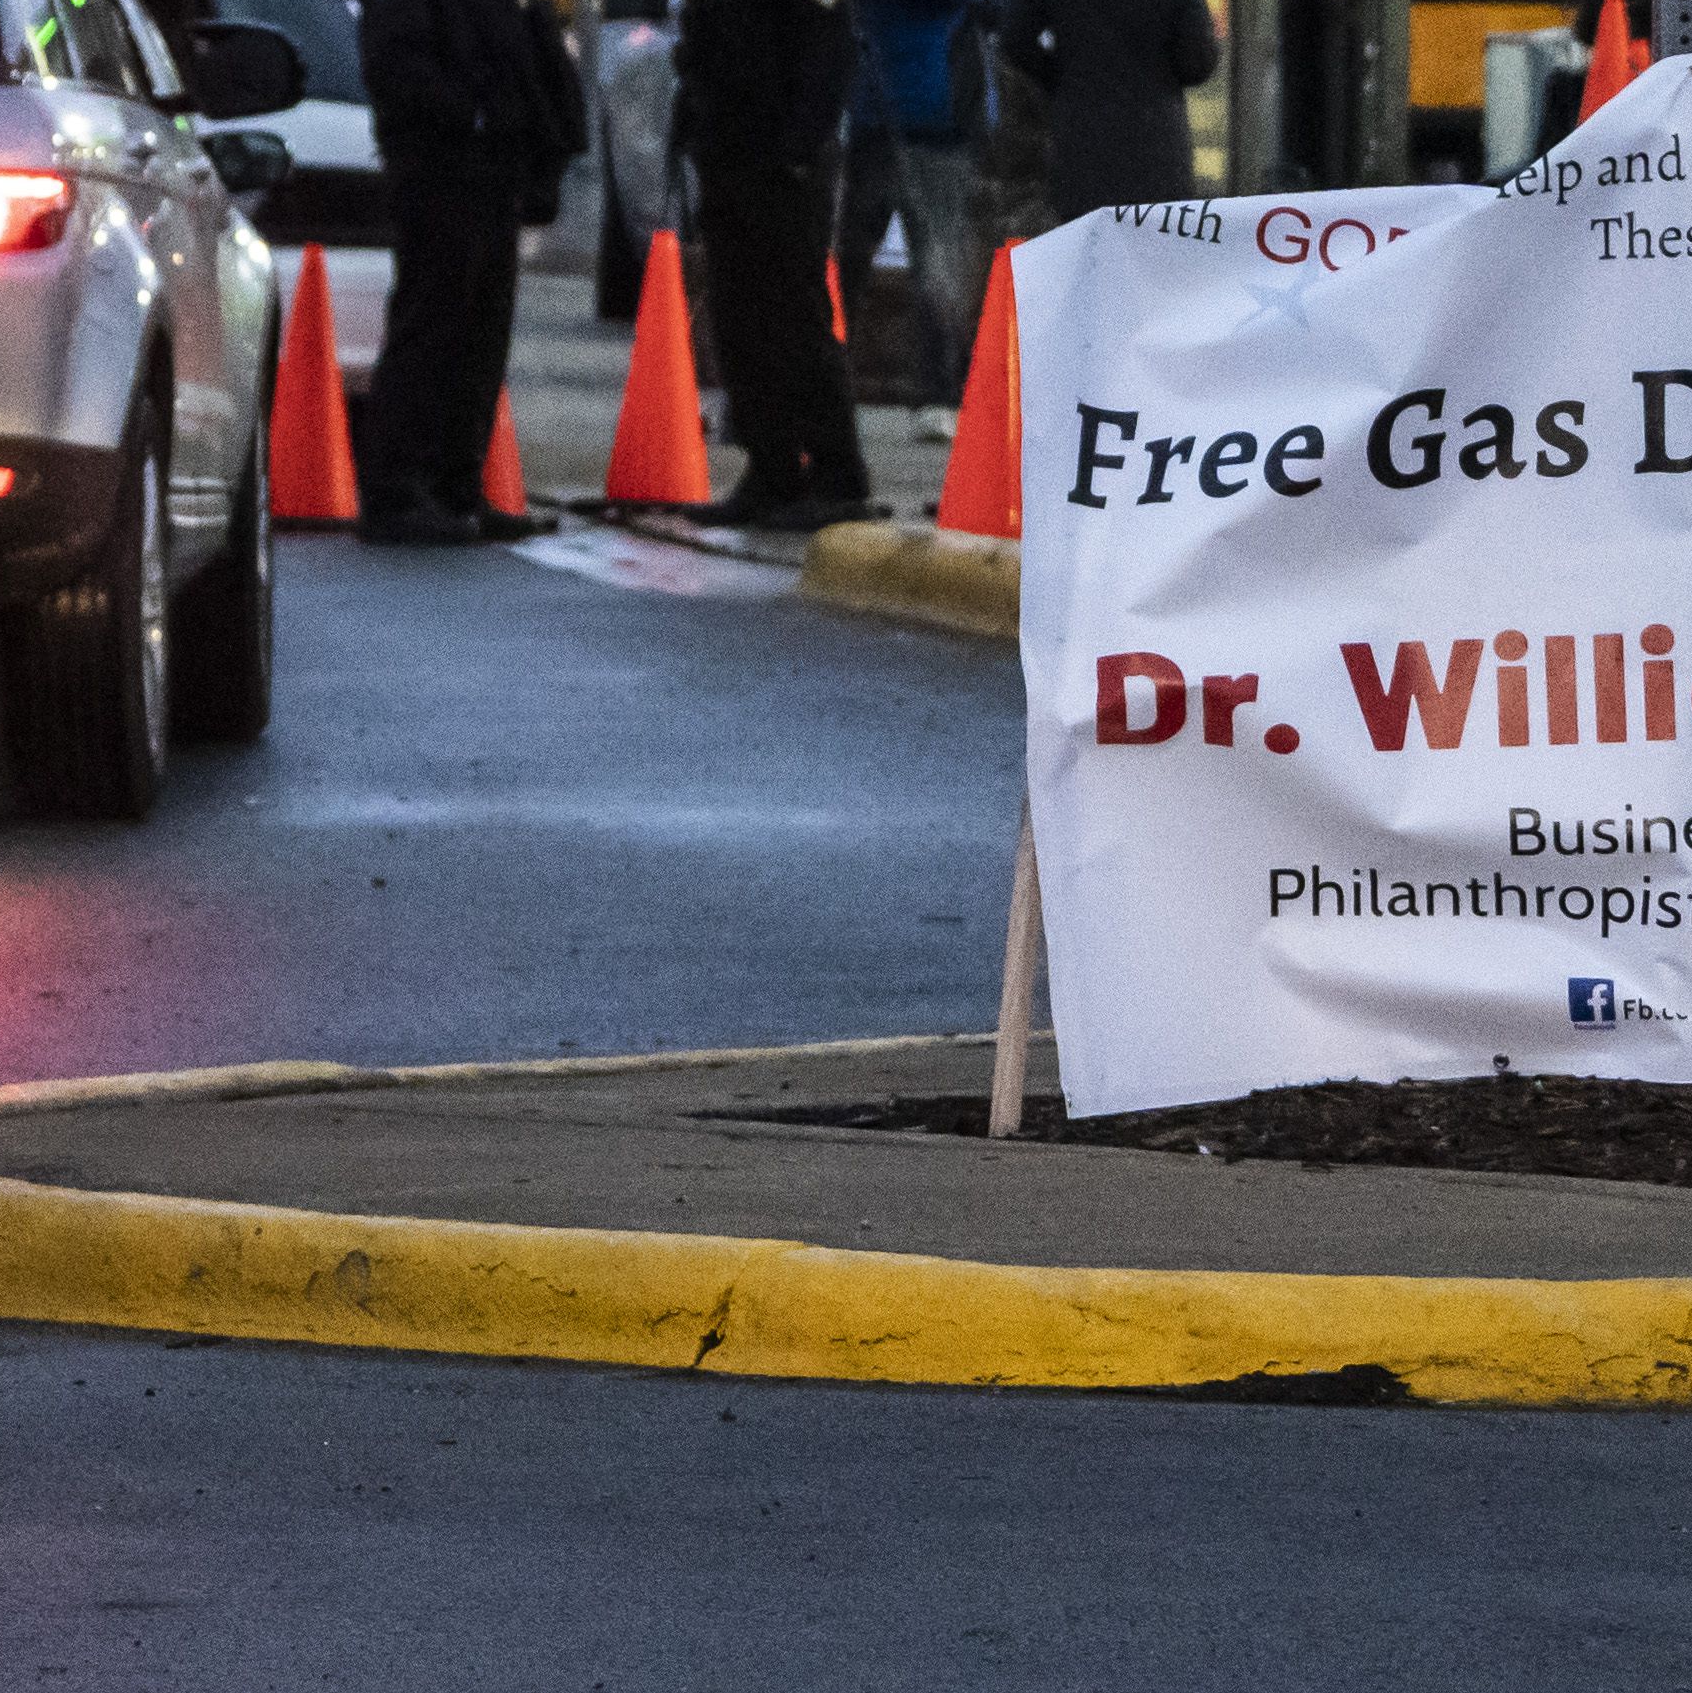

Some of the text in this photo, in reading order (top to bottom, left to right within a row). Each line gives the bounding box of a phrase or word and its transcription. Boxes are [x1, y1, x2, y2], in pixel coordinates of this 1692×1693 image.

[1497, 153, 1584, 206] elp
[1596, 134, 1687, 187] and
[1067, 401, 1326, 510] Free
[1365, 387, 1590, 490] Gas
[1095, 651, 1301, 755] Dr.
